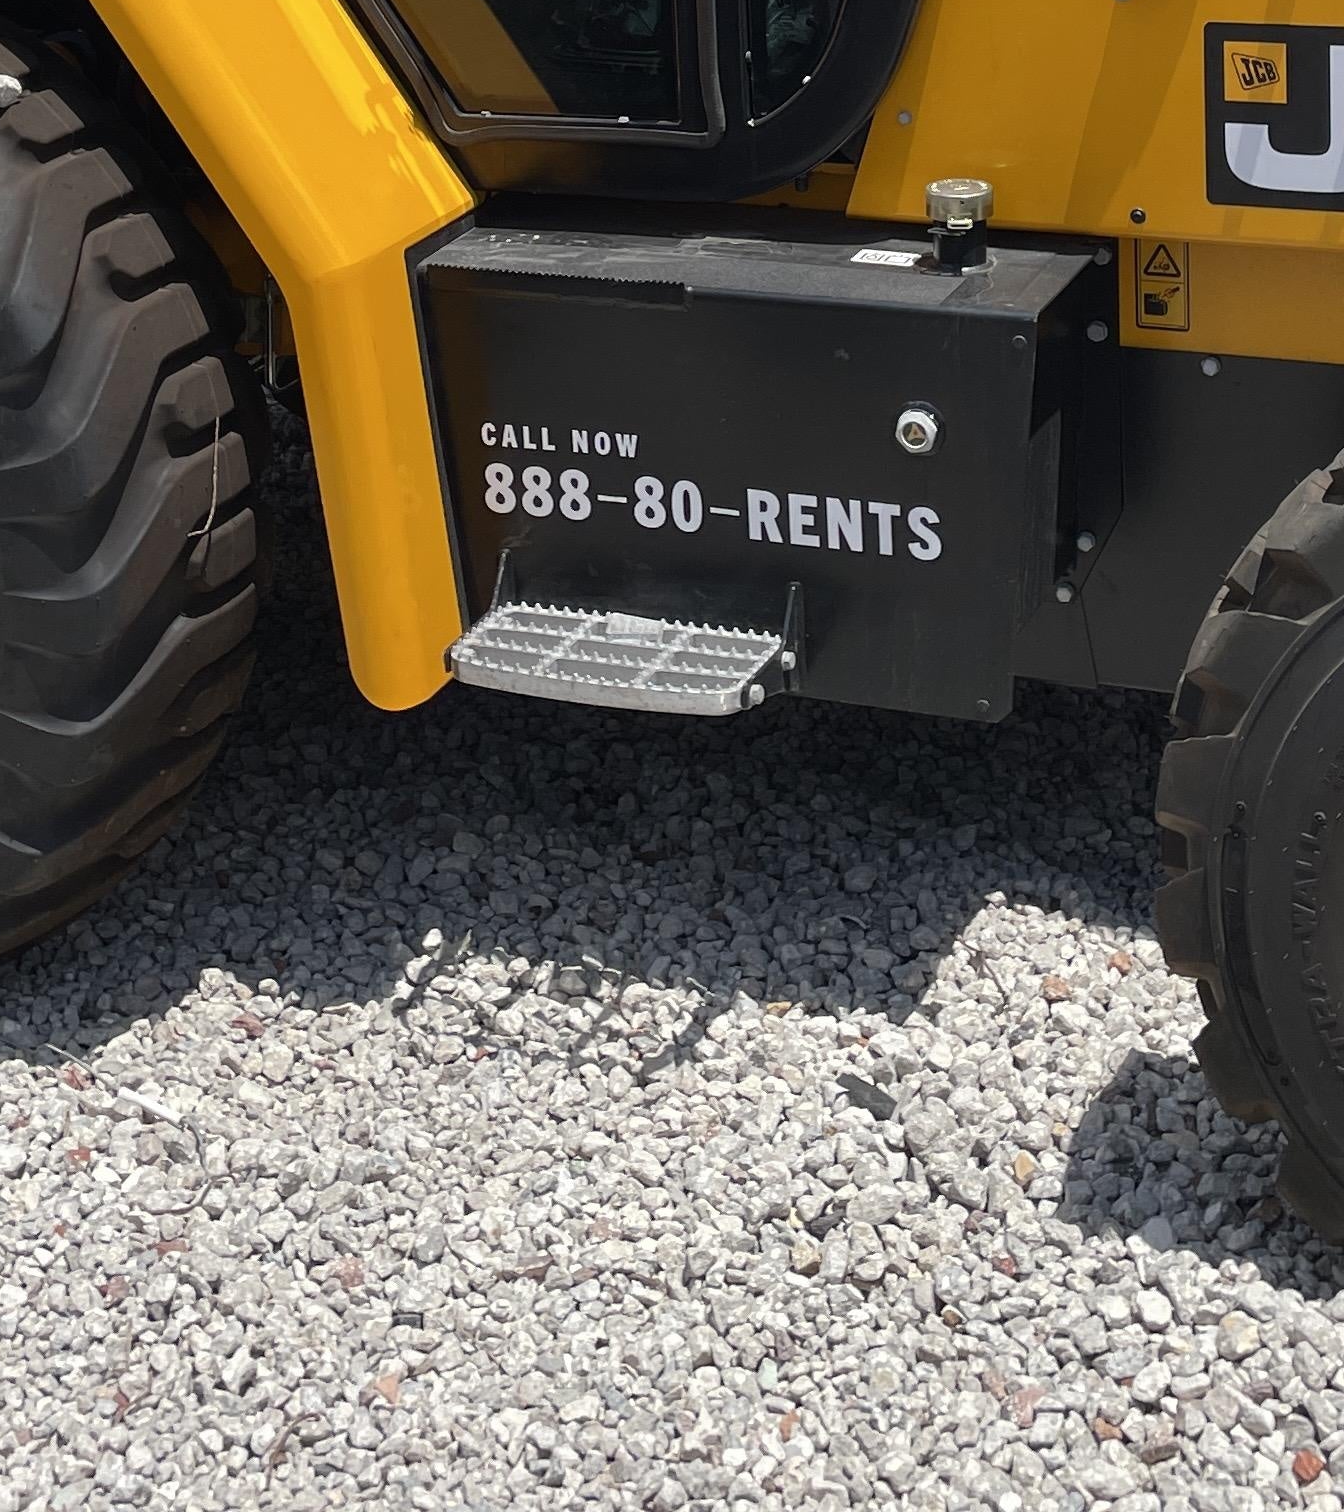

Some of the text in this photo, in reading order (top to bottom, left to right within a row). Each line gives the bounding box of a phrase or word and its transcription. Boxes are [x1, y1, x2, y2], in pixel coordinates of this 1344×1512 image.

[1240, 57, 1276, 86] JCB
[481, 422, 639, 458] CALL NOW
[484, 463, 942, 561] 888-80-RENTS
